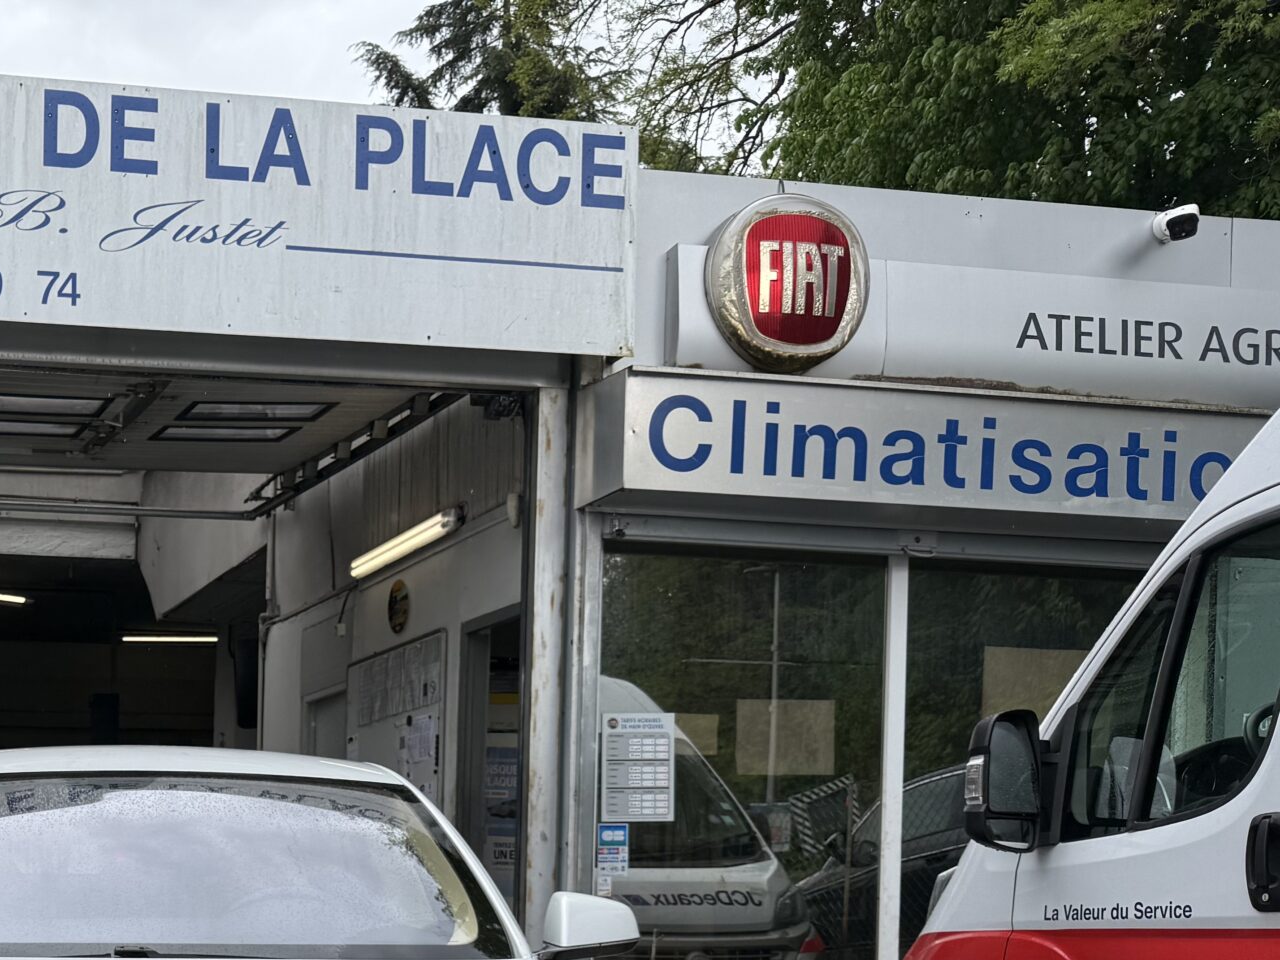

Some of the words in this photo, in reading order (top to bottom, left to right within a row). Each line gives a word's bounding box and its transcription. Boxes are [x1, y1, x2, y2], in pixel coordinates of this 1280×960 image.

[43, 90, 158, 175] DE
[206, 103, 310, 186] LA
[355, 115, 626, 210] PLACE
[99, 199, 289, 253] Justet
[38, 271, 80, 305] 74
[759, 240, 845, 317] FIAT
[1016, 312, 1183, 360] ATELIER
[1199, 325, 1280, 367] AGR
[649, 395, 1233, 503] Climatisatio
[1043, 904, 1059, 921] La
[1063, 903, 1106, 921] Valeur
[1110, 903, 1129, 920] du
[1133, 901, 1193, 920] Service
